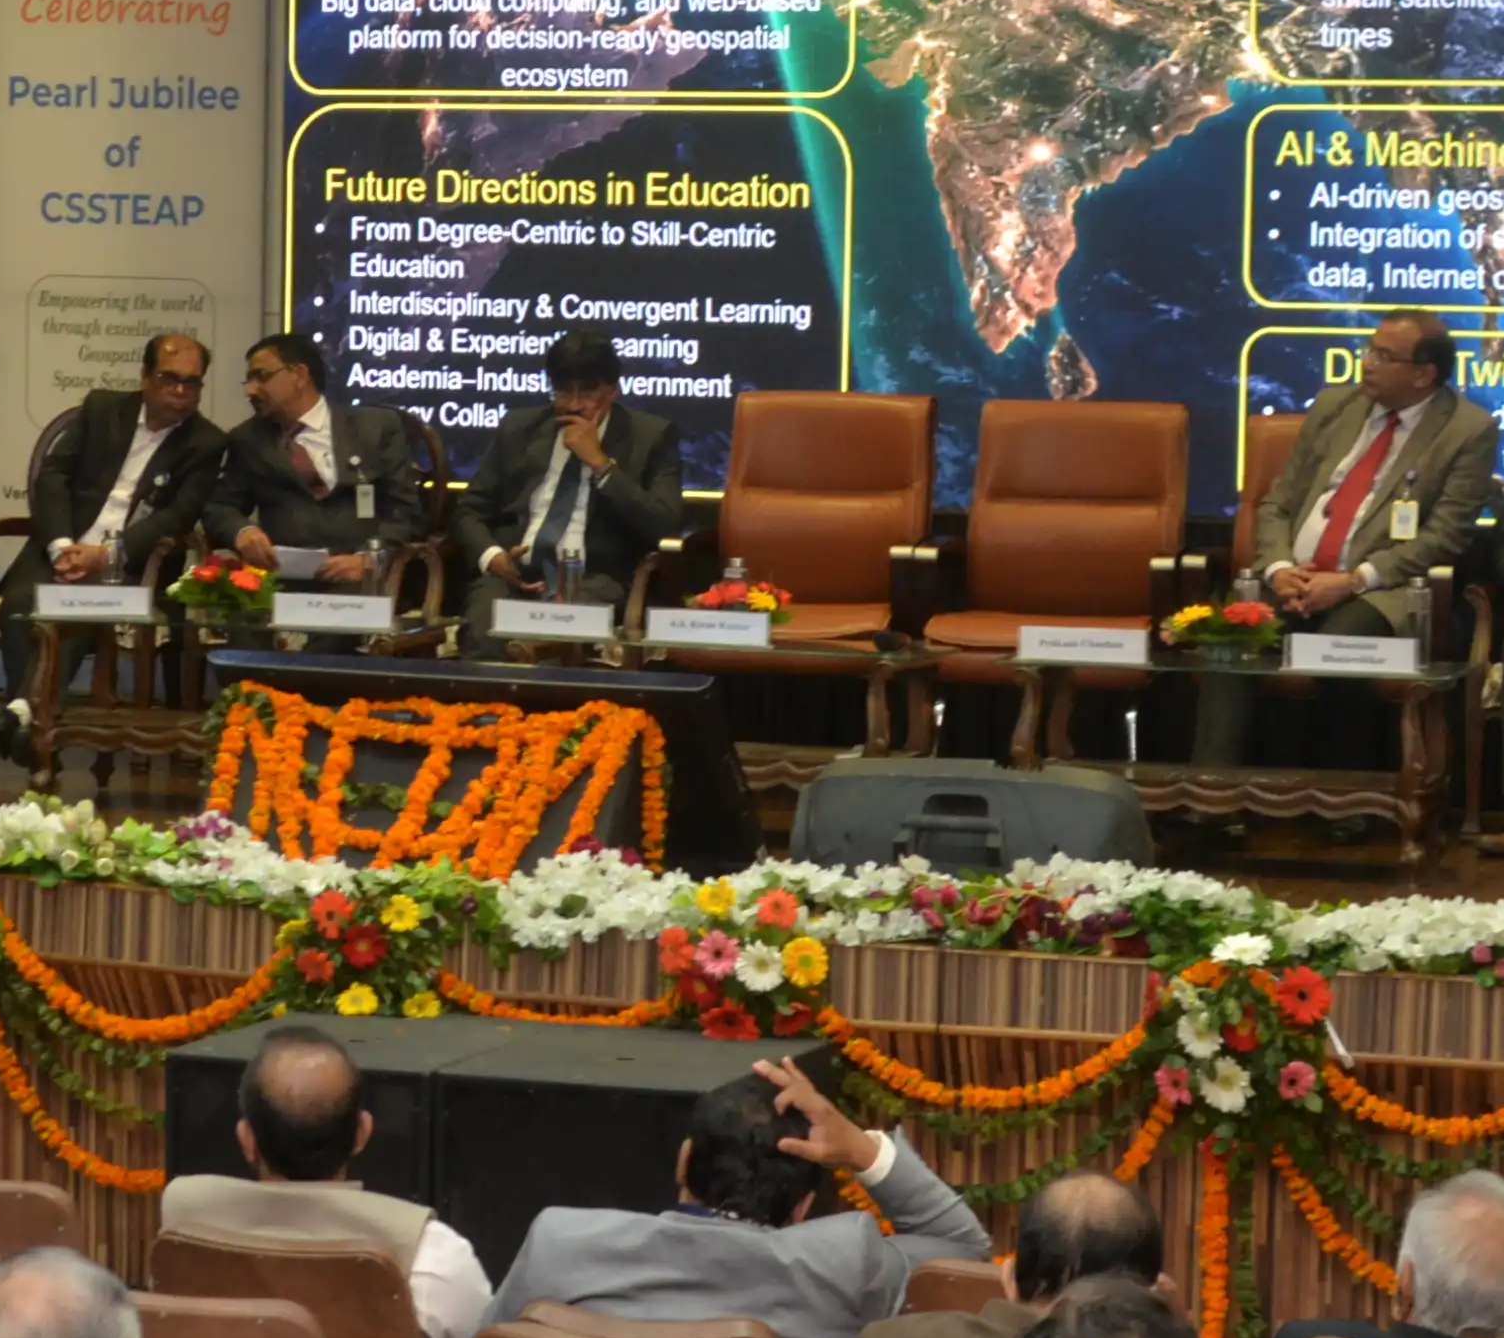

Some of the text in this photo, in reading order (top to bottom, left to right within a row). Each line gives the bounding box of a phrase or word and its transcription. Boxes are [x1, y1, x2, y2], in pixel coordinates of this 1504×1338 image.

[349, 25, 791, 55] platform for decision-ready geospatial
[1321, 22, 1392, 50] times
[501, 63, 628, 91] ecosystem
[8, 76, 240, 110] Pearl Jubilee
[104, 136, 141, 168] of
[1277, 134, 1314, 167] AI
[1324, 132, 1355, 168] &
[325, 168, 811, 209] Future Directions in Education
[1310, 183, 1430, 212] AI-driven
[41, 191, 205, 227] CSSTEAP
[351, 218, 776, 249] From Degree-Centric to Skill-Centric
[1310, 223, 1451, 254] Integration
[1459, 223, 1485, 251] of
[350, 253, 464, 280] Education
[1308, 262, 1375, 291] data,
[1383, 263, 1485, 291] Internet
[38, 290, 204, 316] Empowering the world
[350, 290, 811, 330] Interdisciplinary & Convergent Learning
[43, 316, 100, 339] through
[349, 327, 419, 356] Digital
[426, 329, 444, 354] &
[613, 334, 698, 364] earning
